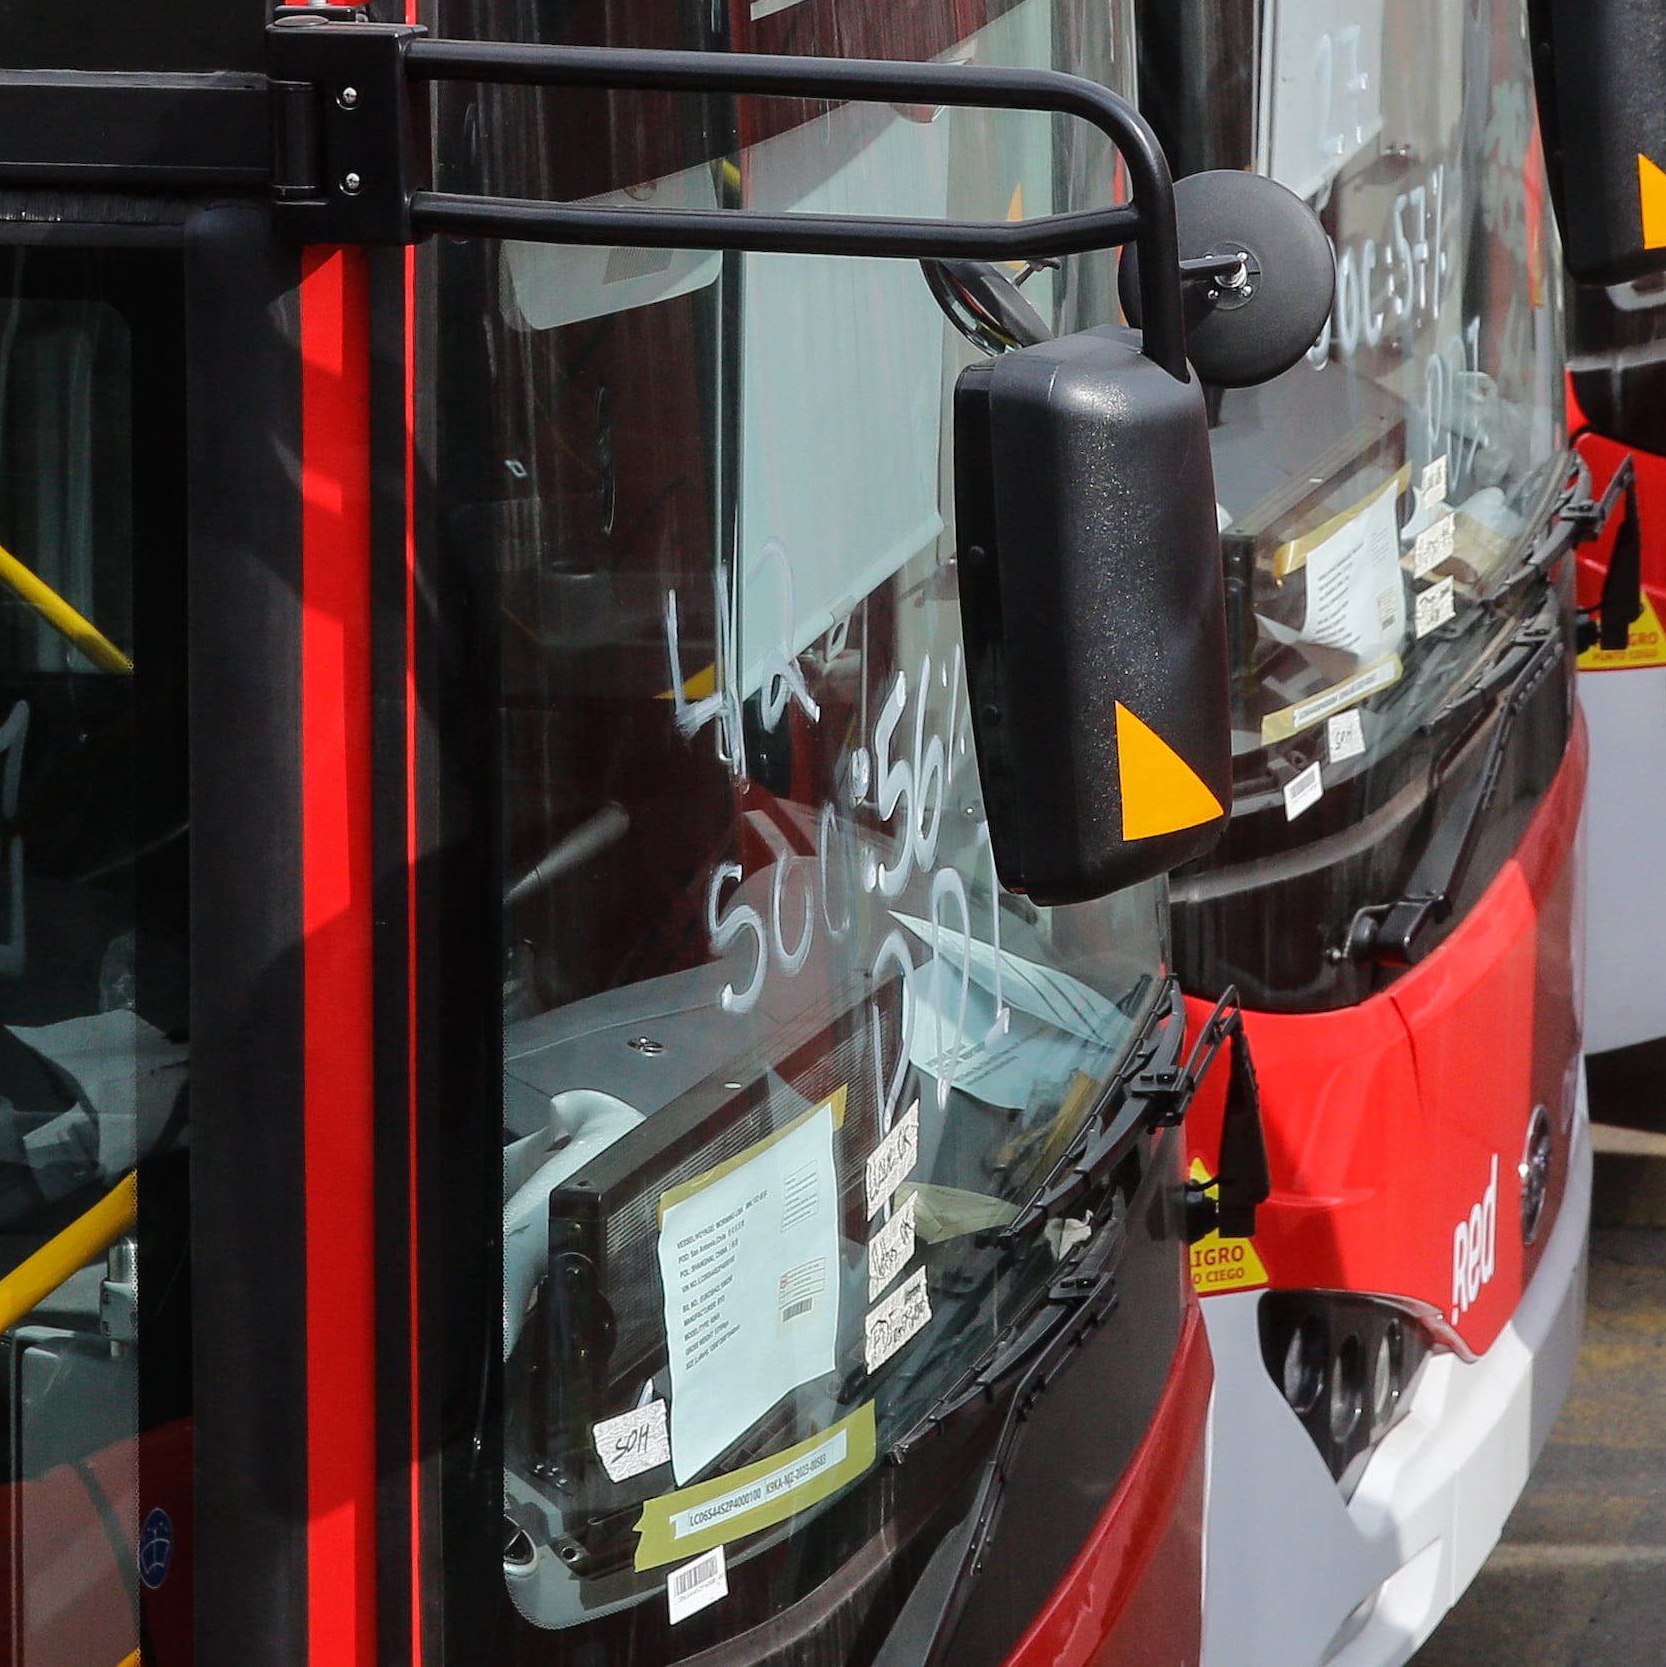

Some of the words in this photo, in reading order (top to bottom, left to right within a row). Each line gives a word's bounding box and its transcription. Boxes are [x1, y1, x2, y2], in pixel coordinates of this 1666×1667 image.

[1451, 1152, 1500, 1327] Red
[1195, 1245, 1244, 1268] IGRO
[1206, 1267, 1245, 1283] CIEGO
